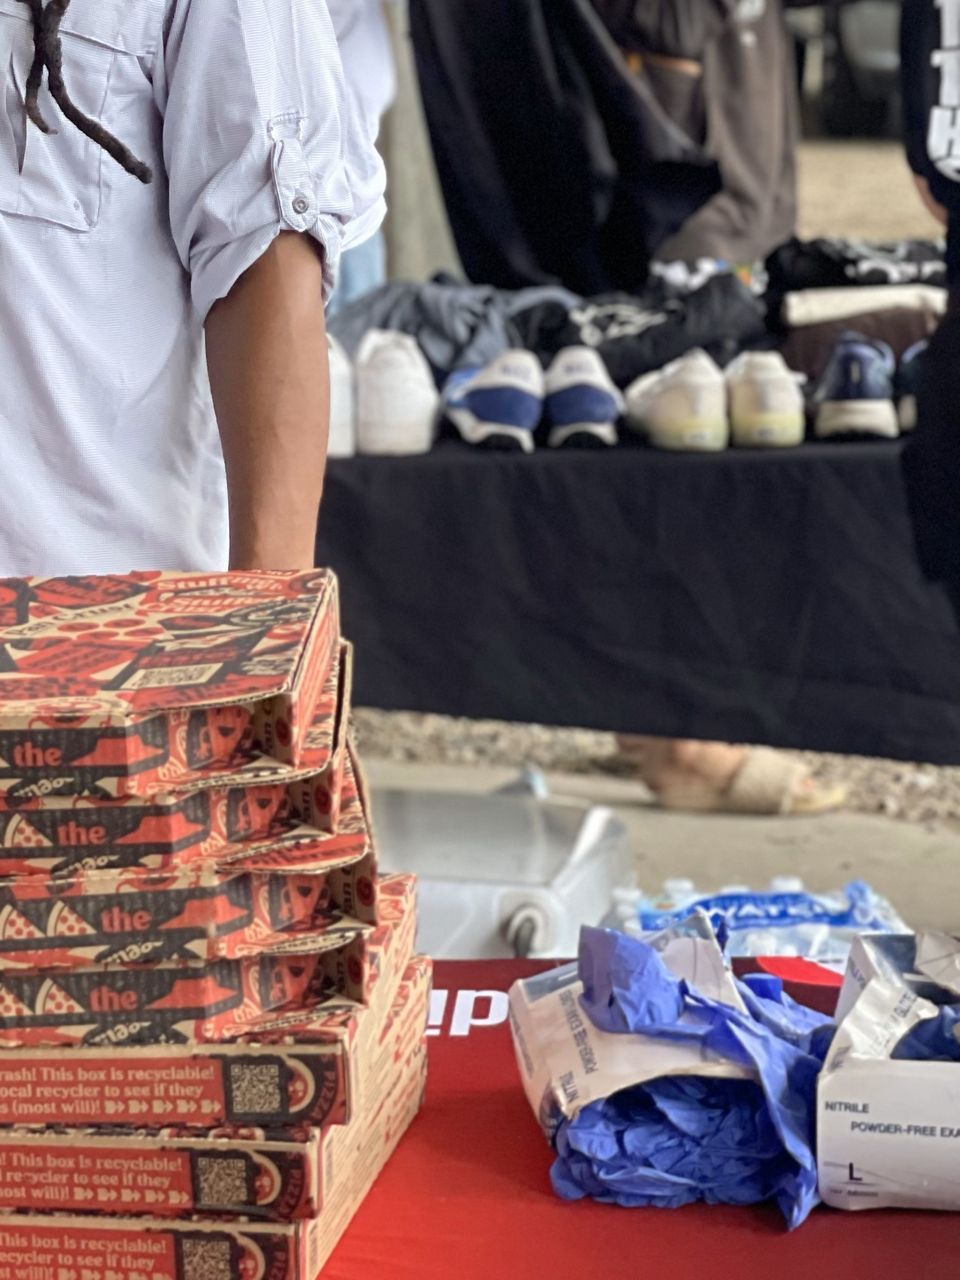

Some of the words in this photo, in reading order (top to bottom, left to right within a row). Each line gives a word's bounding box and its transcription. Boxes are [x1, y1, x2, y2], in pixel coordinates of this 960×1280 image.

[13, 741, 62, 767] the
[57, 821, 107, 847] the
[100, 906, 153, 934] the
[88, 985, 139, 1013] the
[41, 1068, 73, 1081] This
[78, 1067, 105, 1081] box
[111, 1067, 124, 1081] is
[128, 1066, 214, 1082] recyclable!
[36, 1084, 100, 1099] recycler
[105, 1085, 120, 1097] to
[124, 1086, 150, 1097] see
[154, 1083, 166, 1097] if
[169, 1084, 204, 1098] they
[12, 1100, 56, 1115] (most
[61, 1099, 100, 1115] will)!
[825, 1100, 870, 1114] NITRILE
[850, 1121, 937, 1137] POWDER-FREE
[9, 1152, 43, 1166] This
[46, 1154, 75, 1168] box
[79, 1155, 91, 1168] is
[96, 1156, 182, 1171] recyclable!
[6, 1171, 69, 1184] recycler
[73, 1173, 88, 1184] to
[92, 1175, 118, 1185] see
[122, 1172, 134, 1186] if
[137, 1173, 171, 1188] they
[849, 1162, 863, 1181] L
[31, 1185, 70, 1201] will)!
[31, 1233, 60, 1248] box
[64, 1234, 77, 1249] is
[80, 1238, 167, 1253] recyclable!
[58, 1253, 73, 1265] to
[77, 1254, 103, 1266] see
[107, 1253, 121, 1267] if
[121, 1254, 155, 1270] they
